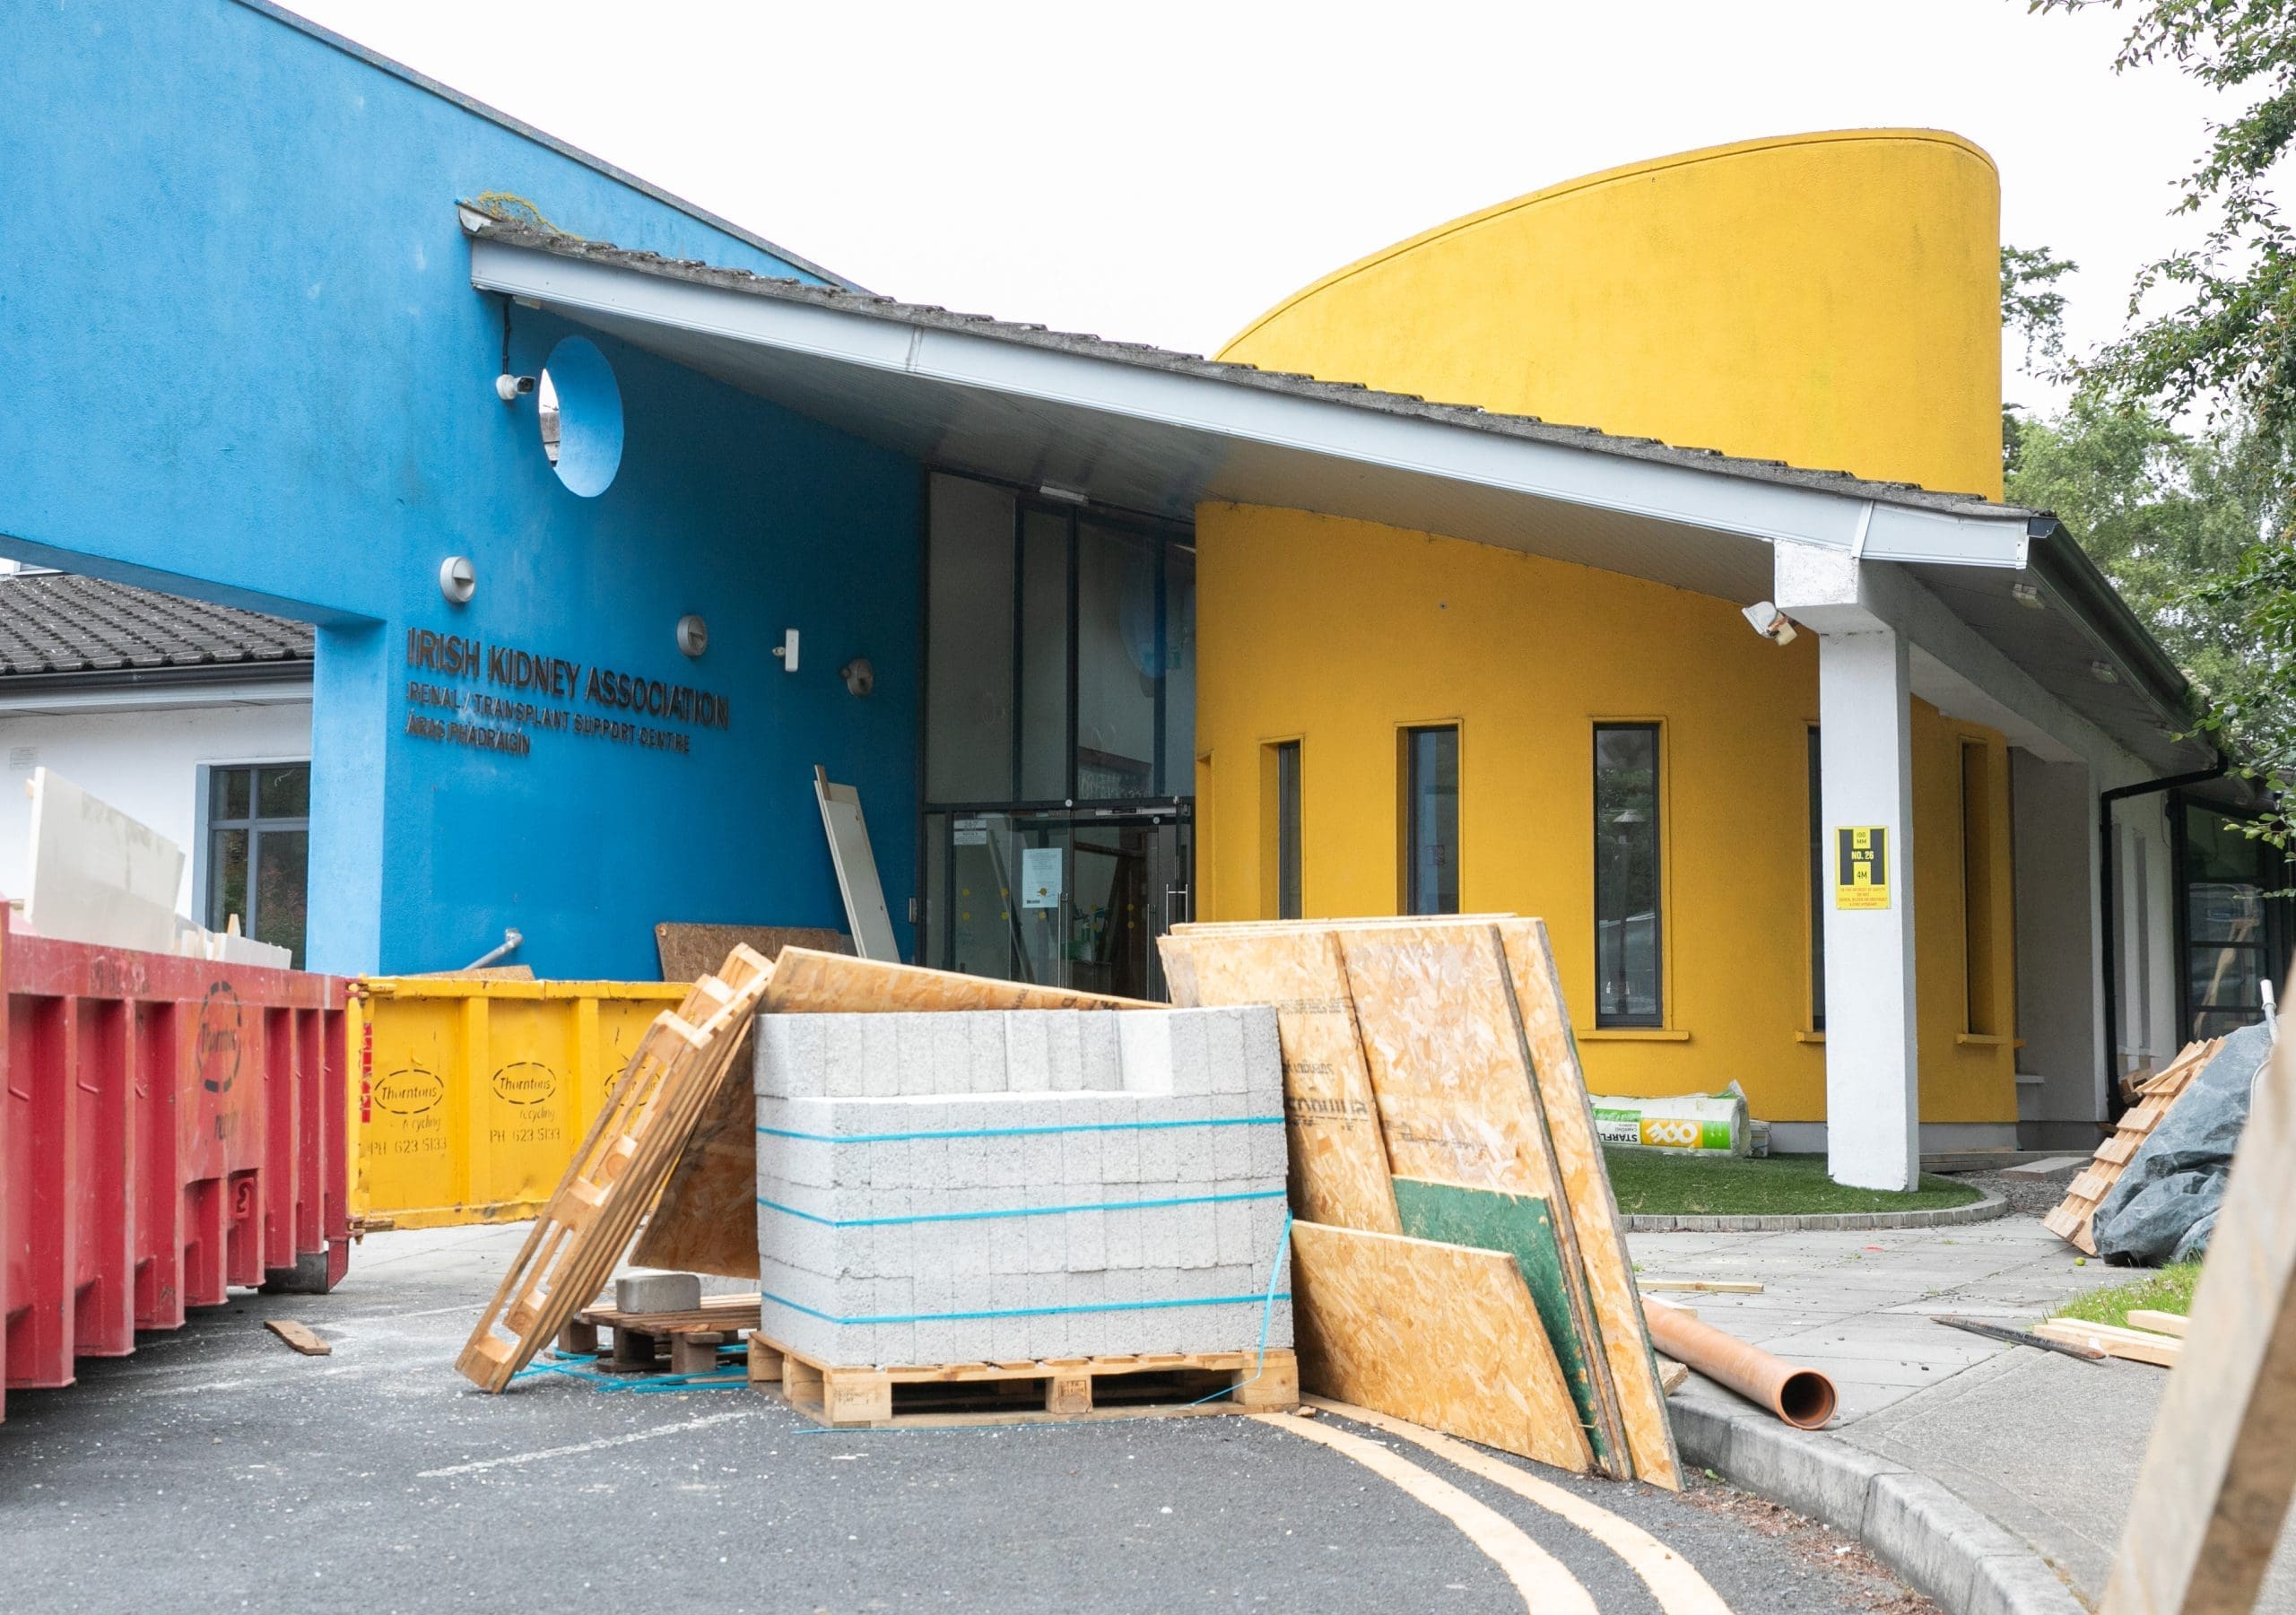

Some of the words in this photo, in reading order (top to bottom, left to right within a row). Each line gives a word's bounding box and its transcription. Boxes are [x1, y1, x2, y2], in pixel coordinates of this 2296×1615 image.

[407, 627, 481, 678] IRISH
[488, 645, 581, 698] KIDNEY
[586, 666, 730, 731] ASSOCIATION
[406, 682, 461, 710] RENAL
[474, 693, 570, 730] TRANSPLANT
[573, 713, 636, 745] SUPPORT
[639, 726, 691, 754] CENTRE
[500, 1077, 551, 1090] Thorntons
[382, 1087, 437, 1100] Thorntons
[1600, 1133, 1638, 1142] STARFL
[395, 1140, 418, 1154] 623
